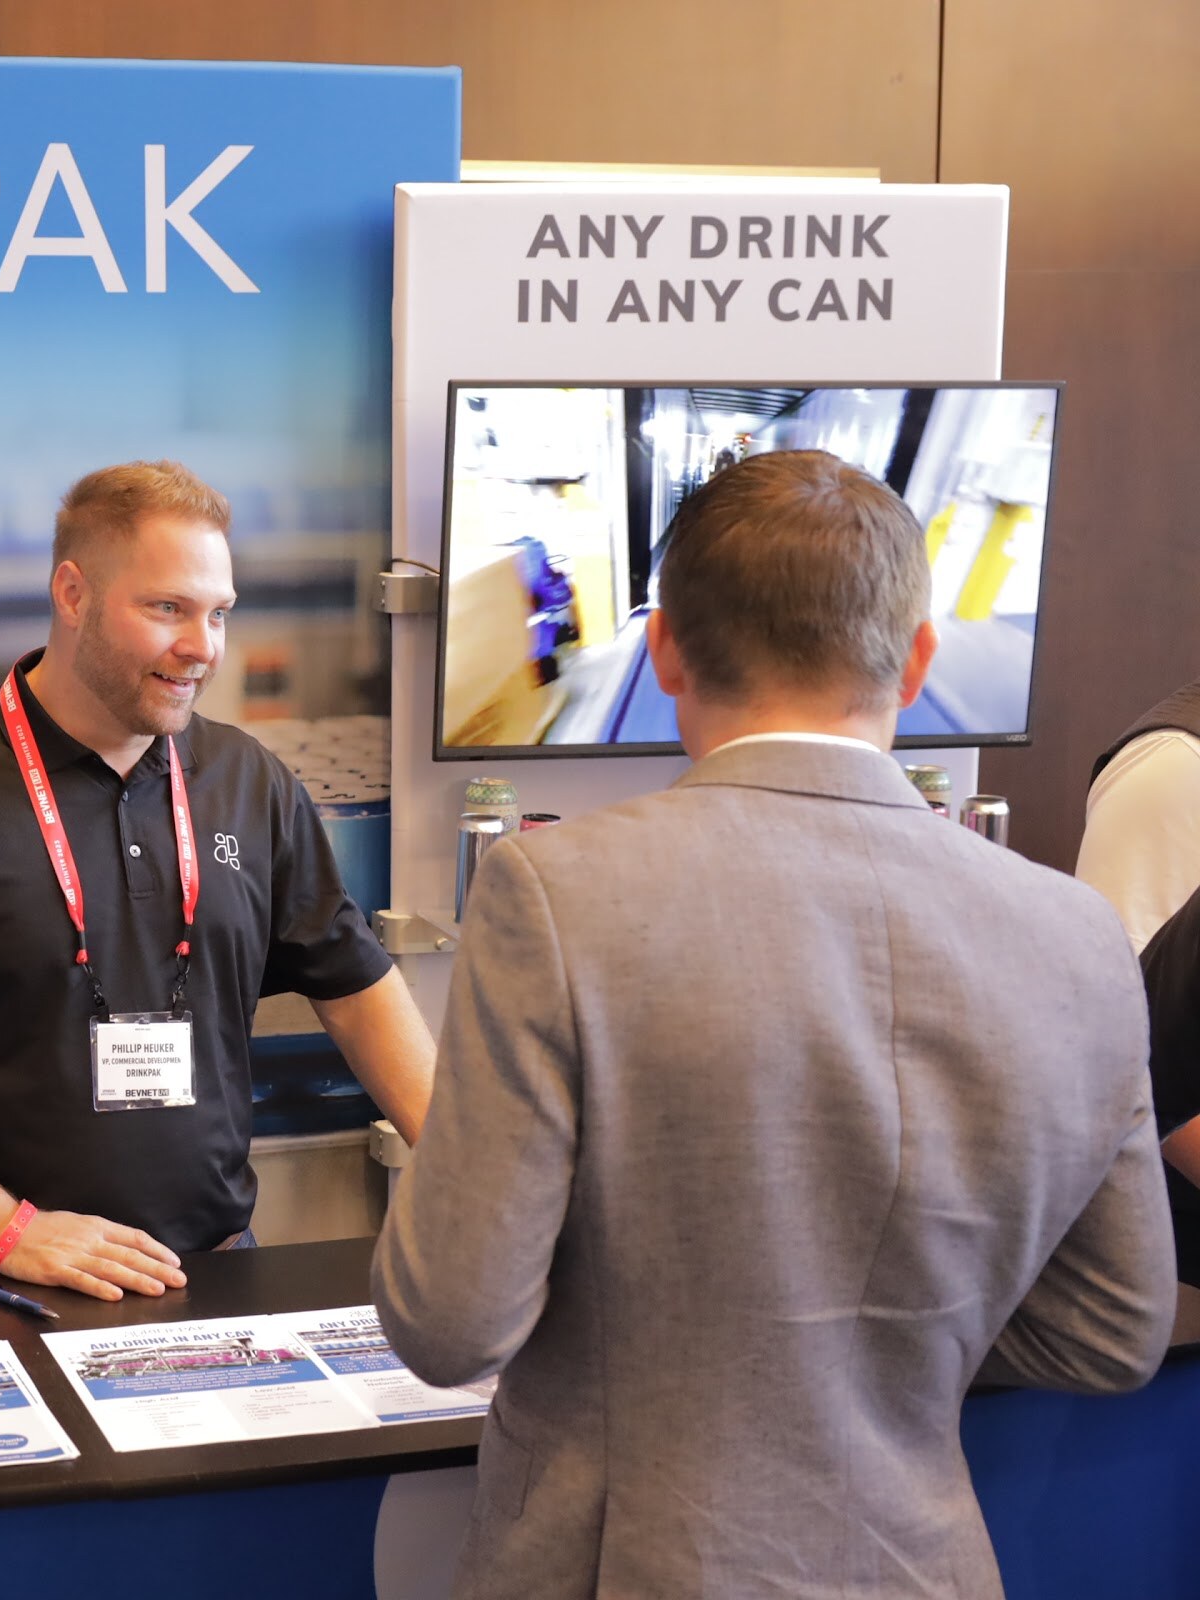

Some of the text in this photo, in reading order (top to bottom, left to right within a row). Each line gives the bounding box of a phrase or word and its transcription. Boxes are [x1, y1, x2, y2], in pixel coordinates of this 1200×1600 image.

[526, 214, 891, 259] ANY DRINK
[517, 278, 893, 323] IN ANY CAN
[16, 724, 26, 740] 2023
[21, 741, 34, 767] WINTER
[28, 768, 42, 785] LIVE
[34, 783, 56, 824] BEVNET
[177, 806, 191, 848] BEVNET
[54, 840, 63, 857] 2023
[59, 859, 71, 886] WINTER
[111, 1043, 175, 1054] PHILLIP HEUKER
[101, 1058, 111, 1066] VP,
[111, 1057, 147, 1065] COMMERCIAL
[126, 1068, 162, 1078] DRINKPAK
[125, 1088, 158, 1097] BEVNET
[319, 1320, 347, 1330] ANY
[90, 1329, 255, 1350] ANY DRINK IN ANY CAN
